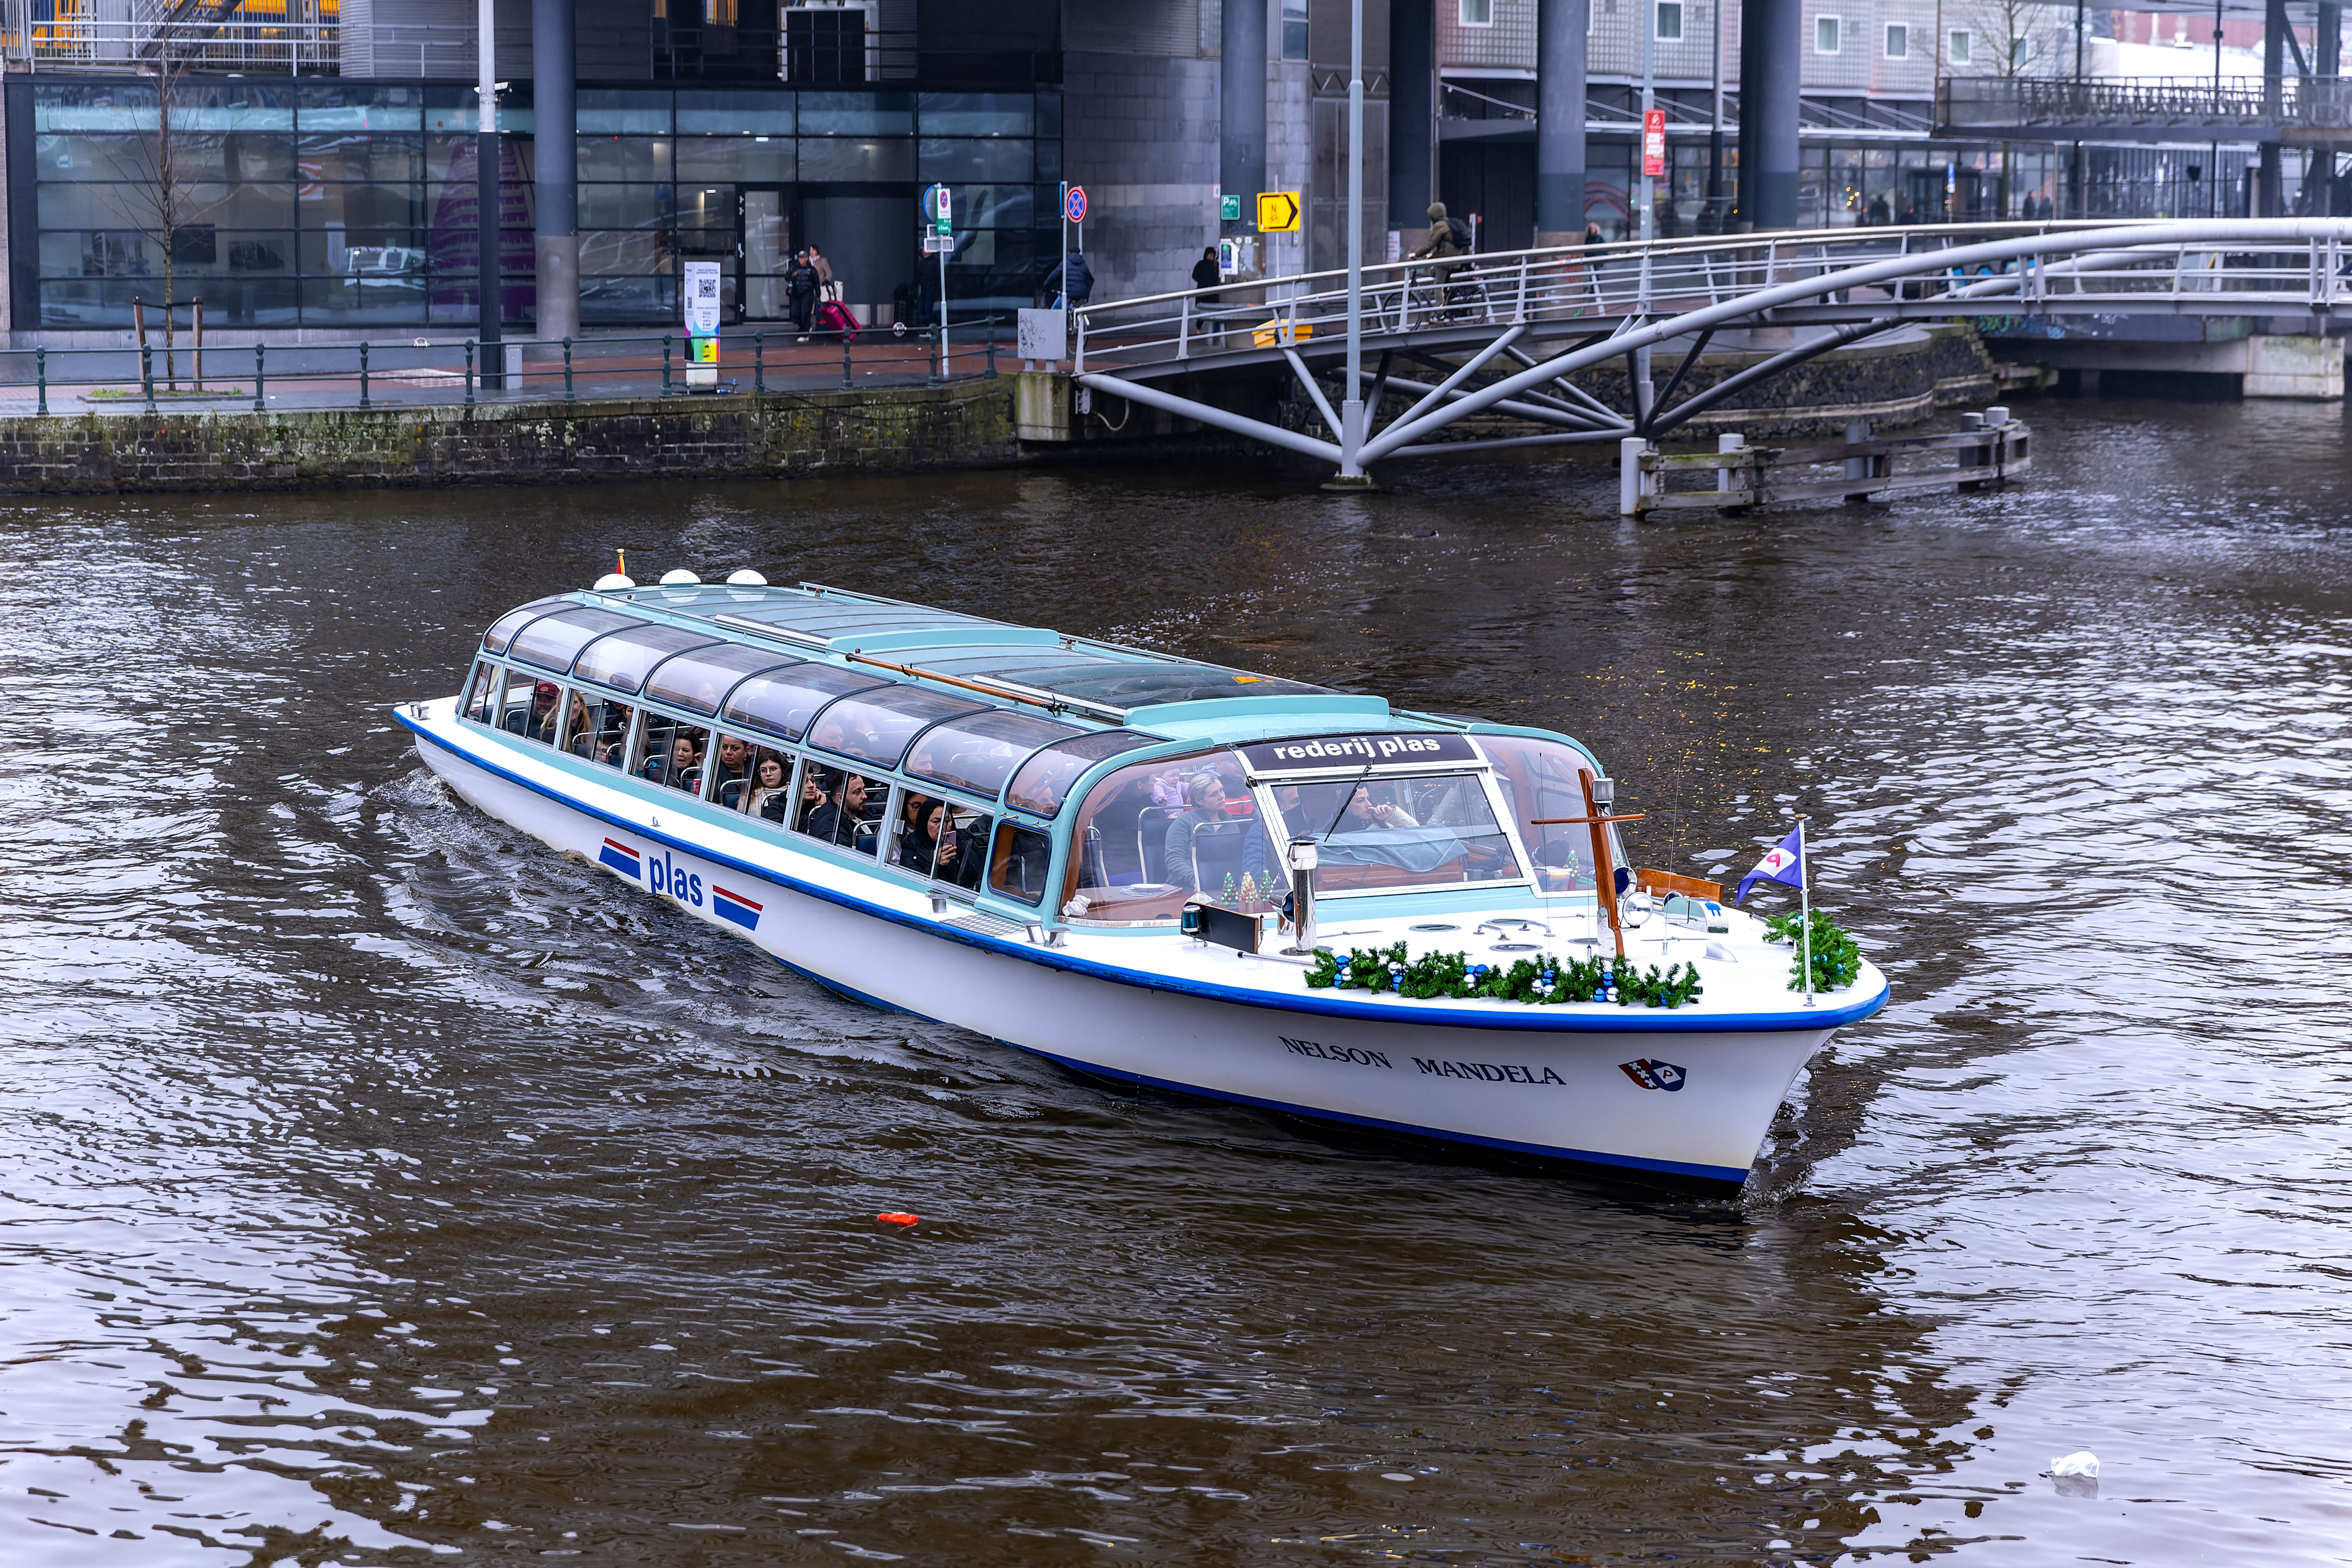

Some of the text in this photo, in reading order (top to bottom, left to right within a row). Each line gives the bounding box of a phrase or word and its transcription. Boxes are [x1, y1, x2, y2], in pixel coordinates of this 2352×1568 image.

[1223, 196, 1230, 206] P
[1273, 736, 1441, 759] rederij plas
[649, 851, 703, 907] plas
[1278, 1035, 1567, 1085] NELSON MANDELA
[1662, 1069, 1673, 1079] P
